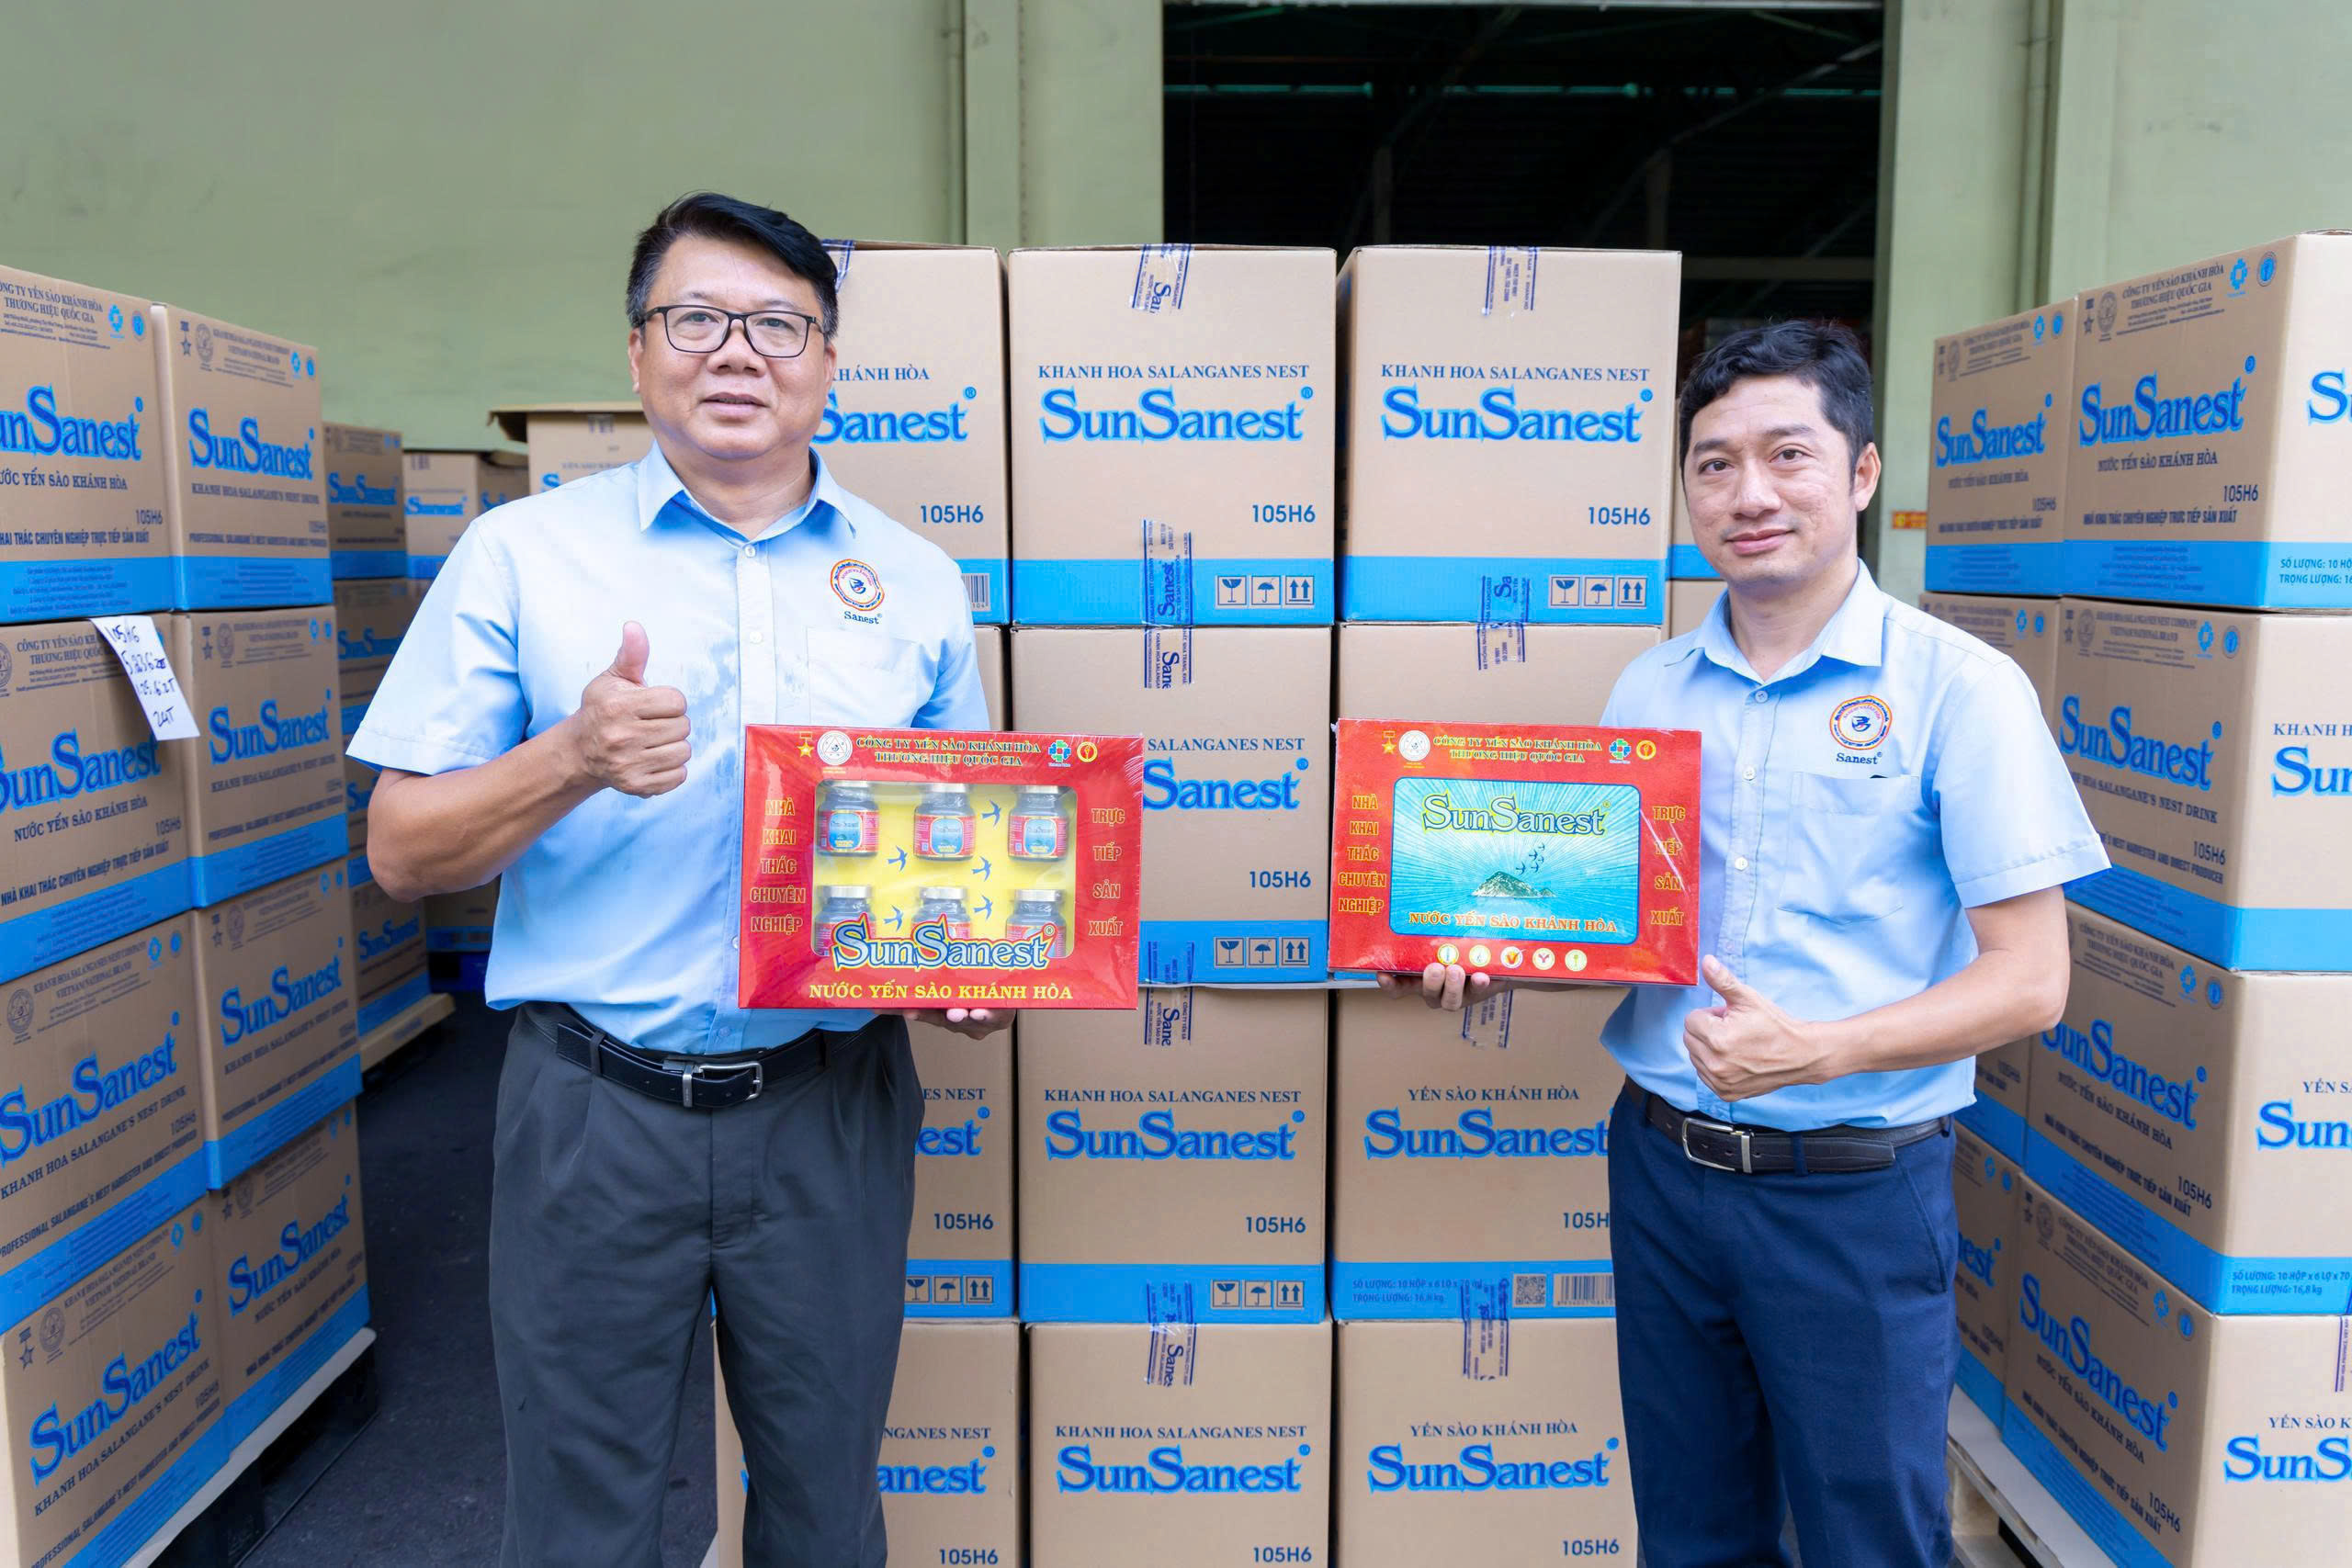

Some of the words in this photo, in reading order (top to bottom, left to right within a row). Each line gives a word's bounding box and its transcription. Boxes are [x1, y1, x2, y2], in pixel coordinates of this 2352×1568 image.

[832, 363, 889, 381] HÁNH
[894, 364, 930, 380] HÒA
[1038, 365, 1102, 378] KHANH
[1108, 366, 1144, 378] HOA
[1148, 366, 1261, 378] SALANGANES
[1266, 365, 1309, 378] NEST
[1381, 364, 1445, 378] KHANH
[1450, 365, 1485, 379] HOA
[1489, 366, 1602, 381] SALANGANES
[1606, 367, 1650, 381] NEST
[1038, 384, 1305, 445] SunSanest
[1381, 382, 1644, 443] SunSanest
[2078, 371, 2247, 446] SunSanest
[188, 407, 314, 481] SunSanest
[1935, 409, 2047, 468] SunSanest
[2121, 452, 2138, 470] YẾN
[2140, 453, 2157, 469] SÀO
[2159, 451, 2194, 468] KHÁNH
[2197, 448, 2218, 466] HÒA
[22, 467, 45, 487] YẾN
[49, 469, 70, 488] SÀO
[73, 473, 107, 489] KHÁNH
[109, 474, 129, 491] HÒA
[2223, 484, 2259, 502] 105H6
[921, 504, 984, 524] 105H6
[1252, 504, 1316, 523] 105H6
[1589, 506, 1651, 525] 105H6
[2293, 558, 2326, 570] LƯỢNG:
[2328, 559, 2338, 569] 10
[2279, 573, 2309, 586] TRỌNG
[2310, 574, 2343, 586] LƯỢNG:
[843, 611, 879, 625] Sanest
[209, 698, 330, 765] SunSanest
[2273, 723, 2336, 736] KHANH
[856, 735, 891, 750] CÔNG
[895, 738, 911, 750] TY
[942, 738, 966, 751] SÀO
[967, 739, 1014, 753] KHÁNH
[1015, 740, 1041, 753] HÒA
[1148, 739, 1258, 750] SALANGANES
[1262, 738, 1305, 750] NEST
[1433, 735, 1464, 747] CÔNG
[1467, 737, 1482, 747] TY
[1510, 737, 1532, 750] SÀO
[1534, 738, 1577, 750] KHÁNH
[1577, 739, 1602, 751] HÒA
[2059, 694, 2214, 792] SunSanest
[964, 751, 999, 766] QUỐC
[1001, 753, 1023, 766] GIA
[1564, 752, 1586, 763] GIA
[1836, 752, 1878, 764] Sanest
[765, 798, 795, 816] NHÀ
[1352, 794, 1378, 809] NHÀ
[2159, 795, 2183, 814] NEST
[2186, 804, 2218, 823] DRINK
[14, 820, 44, 842] NƯỚC
[47, 812, 70, 833] YẾN
[72, 808, 93, 827] SÀO
[95, 800, 129, 821] KHÁNH
[1091, 808, 1125, 825] TRỰC
[1421, 788, 1607, 837] SunSanest
[1653, 806, 1686, 823] TRỰC
[763, 829, 797, 845] KHAI
[1350, 820, 1379, 835] KHAI
[1093, 839, 1122, 861] TIẾP
[1347, 845, 1380, 861] THÁC
[2194, 840, 2226, 865] 105H6
[761, 855, 797, 874] THÁC
[18, 884, 37, 899] KHAI
[39, 874, 57, 894] THÁC
[1250, 871, 1311, 888] 105H6
[1338, 870, 1386, 887] CHUYÊN
[1655, 872, 1682, 890] SẢN
[751, 884, 806, 903] CHUYÊN
[1092, 880, 1121, 899] SẢN
[1338, 897, 1384, 915] NGHIỆP
[751, 915, 803, 933] NGHIỆP
[1408, 911, 1450, 925] NƯỚC
[1454, 910, 1486, 926] YẾN
[1490, 913, 1520, 928] SÀO
[1524, 915, 1579, 931] KHÁNH
[1585, 918, 1617, 932] HÒA
[1650, 907, 1684, 926] XUẤT
[1089, 916, 1123, 937] XUẤT
[809, 981, 862, 998] NƯỚC
[869, 979, 909, 998] YẾN
[914, 982, 952, 999] SÀO
[959, 980, 1031, 999] KHÁNH
[1034, 982, 1073, 999] HÒA
[220, 955, 343, 1046] SunSanest
[944, 1089, 986, 1100] NEST
[1408, 1084, 1442, 1101] YẾN
[1445, 1085, 1476, 1101] SÀO
[1481, 1086, 1543, 1100] KHÁNH
[1547, 1085, 1579, 1100] HÒA
[2303, 1077, 2336, 1093] YẾN
[1045, 1089, 1105, 1102] KHANH
[1110, 1090, 1144, 1102] HOA
[1148, 1090, 1256, 1103] SALANGANES
[1260, 1090, 1301, 1102] NEST
[1045, 1108, 1295, 1161] SunSanest
[1364, 1106, 1609, 1160] SunSanest
[2116, 1108, 2150, 1136] KHÁNH
[2152, 1126, 2172, 1150] HÒA
[1, 1167, 43, 1200] KHANH
[46, 1155, 69, 1176] HOA
[2178, 1175, 2211, 1209] 105H6
[933, 1213, 994, 1230] 105H6
[1245, 1216, 1306, 1234] 105H6
[229, 1193, 351, 1319] SunSanest
[2018, 1271, 2168, 1452] SunSanest
[29, 1309, 201, 1487] SunSanest
[1410, 1421, 1443, 1438] YẾN
[1447, 1422, 1477, 1437] SÀO
[1482, 1420, 1541, 1436] KHÁNH
[1546, 1418, 1578, 1435] HÒA
[2269, 1413, 2301, 1428] YẾN
[2305, 1414, 2336, 1428] SÀO
[951, 1427, 990, 1439] NEST
[1056, 1426, 1115, 1438] KHANH
[1120, 1427, 1152, 1439] HOA
[1157, 1427, 1263, 1439] SALANGANES
[1267, 1426, 1307, 1438] NEST
[2125, 1438, 2144, 1464] HÒA
[1057, 1443, 1302, 1495] SunSanest
[1367, 1440, 1610, 1494] SunSanest
[34, 1478, 75, 1517] KHANH
[78, 1459, 100, 1482] HOA
[2149, 1492, 2181, 1533] 105H6
[939, 1549, 998, 1565] 105H6
[1252, 1546, 1312, 1562] 105H6
[1563, 1539, 1620, 1556] 105H6
